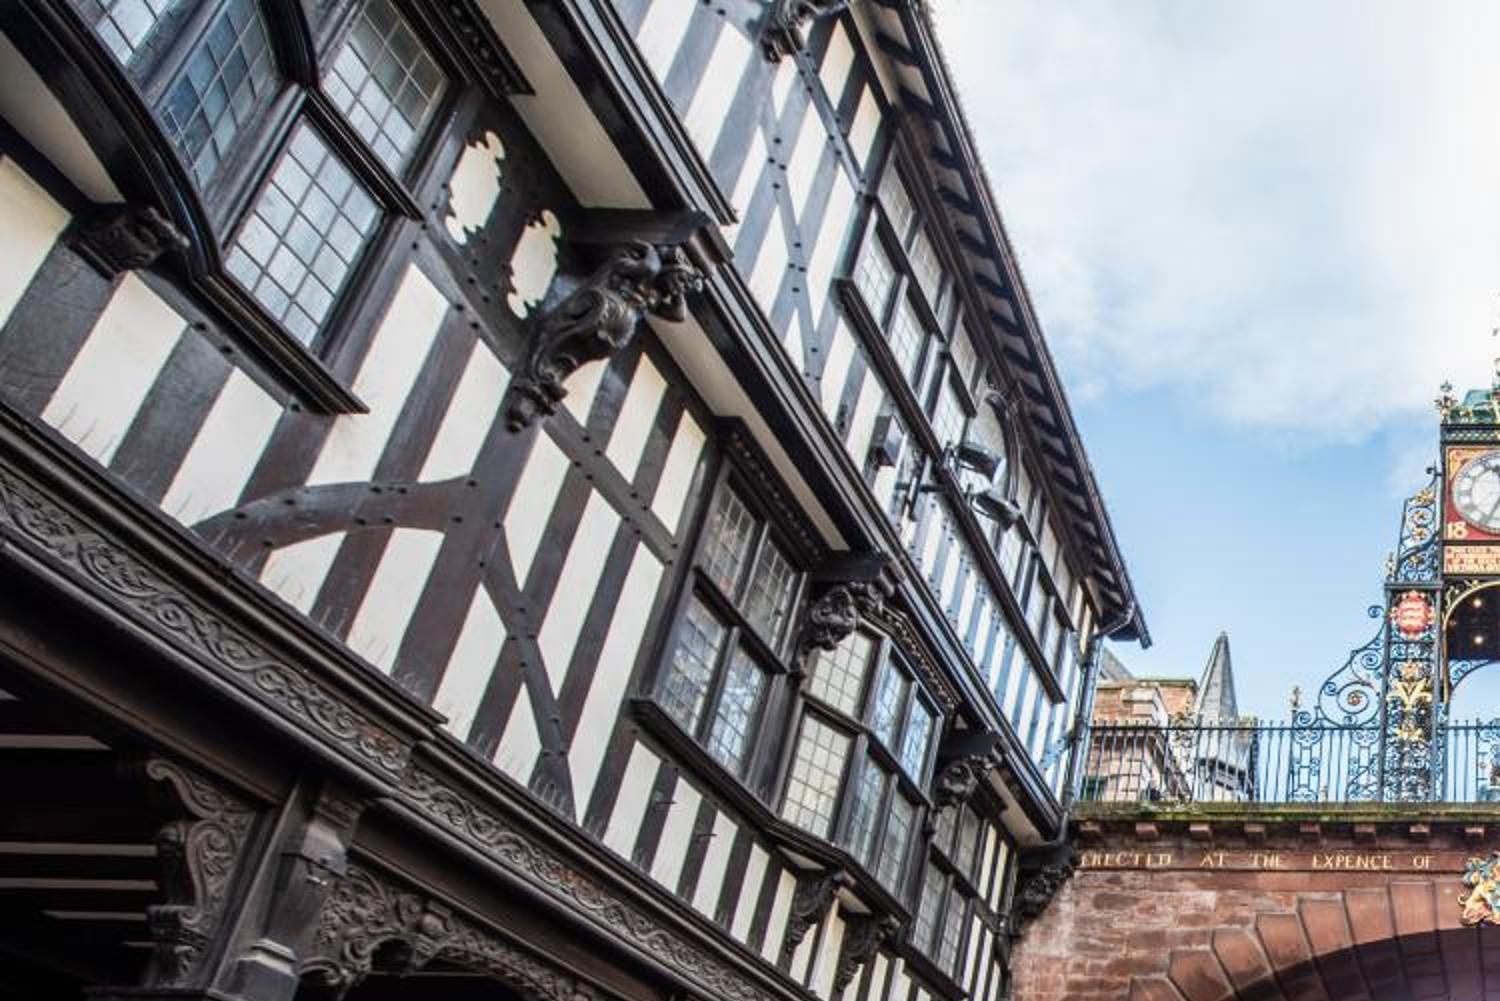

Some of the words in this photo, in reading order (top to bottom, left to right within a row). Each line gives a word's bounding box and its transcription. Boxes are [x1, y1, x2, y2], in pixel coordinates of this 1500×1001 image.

[1447, 521, 1467, 539] 18
[1080, 853, 1172, 867] ERECTED
[1200, 853, 1229, 867] AT
[1250, 853, 1283, 867] THE
[1312, 854, 1393, 869] EXPENCE
[1412, 855, 1435, 869] OF
